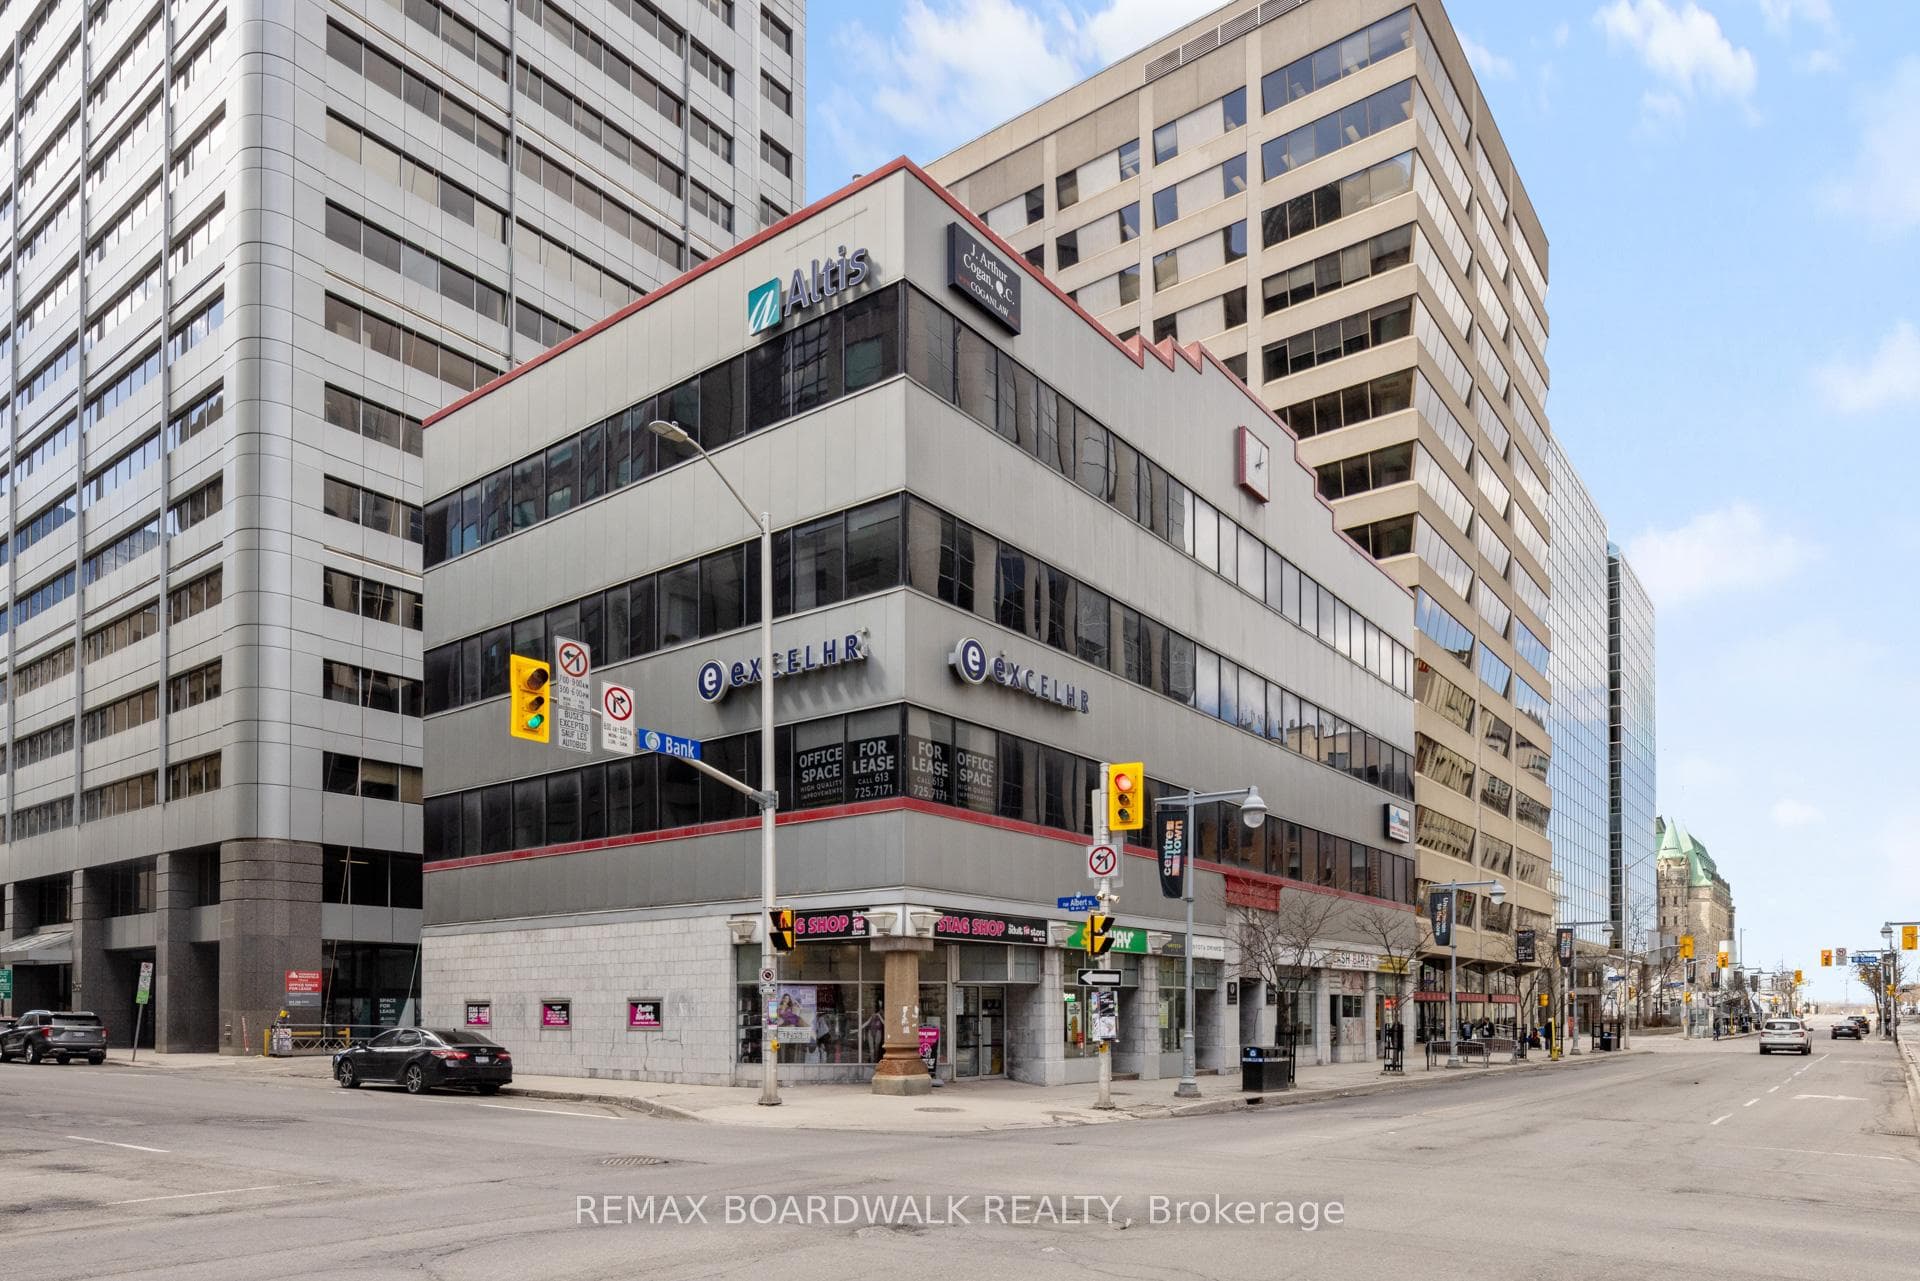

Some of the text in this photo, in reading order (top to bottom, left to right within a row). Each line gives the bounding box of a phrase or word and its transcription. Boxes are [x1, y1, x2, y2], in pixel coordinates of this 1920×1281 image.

[963, 254, 994, 290] Cogan,
[971, 244, 1008, 283] J. Arthur
[784, 245, 869, 317] Altis
[970, 281, 1009, 317] COGANLAW
[559, 718, 589, 732] EXCEPTED
[665, 736, 695, 759] Bank
[860, 740, 887, 757] FOR
[918, 741, 943, 760] FOR
[800, 747, 842, 768] OFFICE
[853, 755, 894, 774] LEASE
[912, 756, 948, 777] LEASE
[957, 752, 994, 773] OFFICE
[802, 764, 840, 783] SPACE
[874, 772, 889, 783] 613
[932, 777, 944, 787] 613
[960, 768, 993, 787] SPACE
[855, 784, 893, 798] 725.7171
[913, 785, 947, 800] 725.7171
[1070, 898, 1087, 907] Albert
[808, 915, 849, 934] SHOP
[938, 915, 1005, 936] STAG SHOP
[1030, 928, 1046, 937] store
